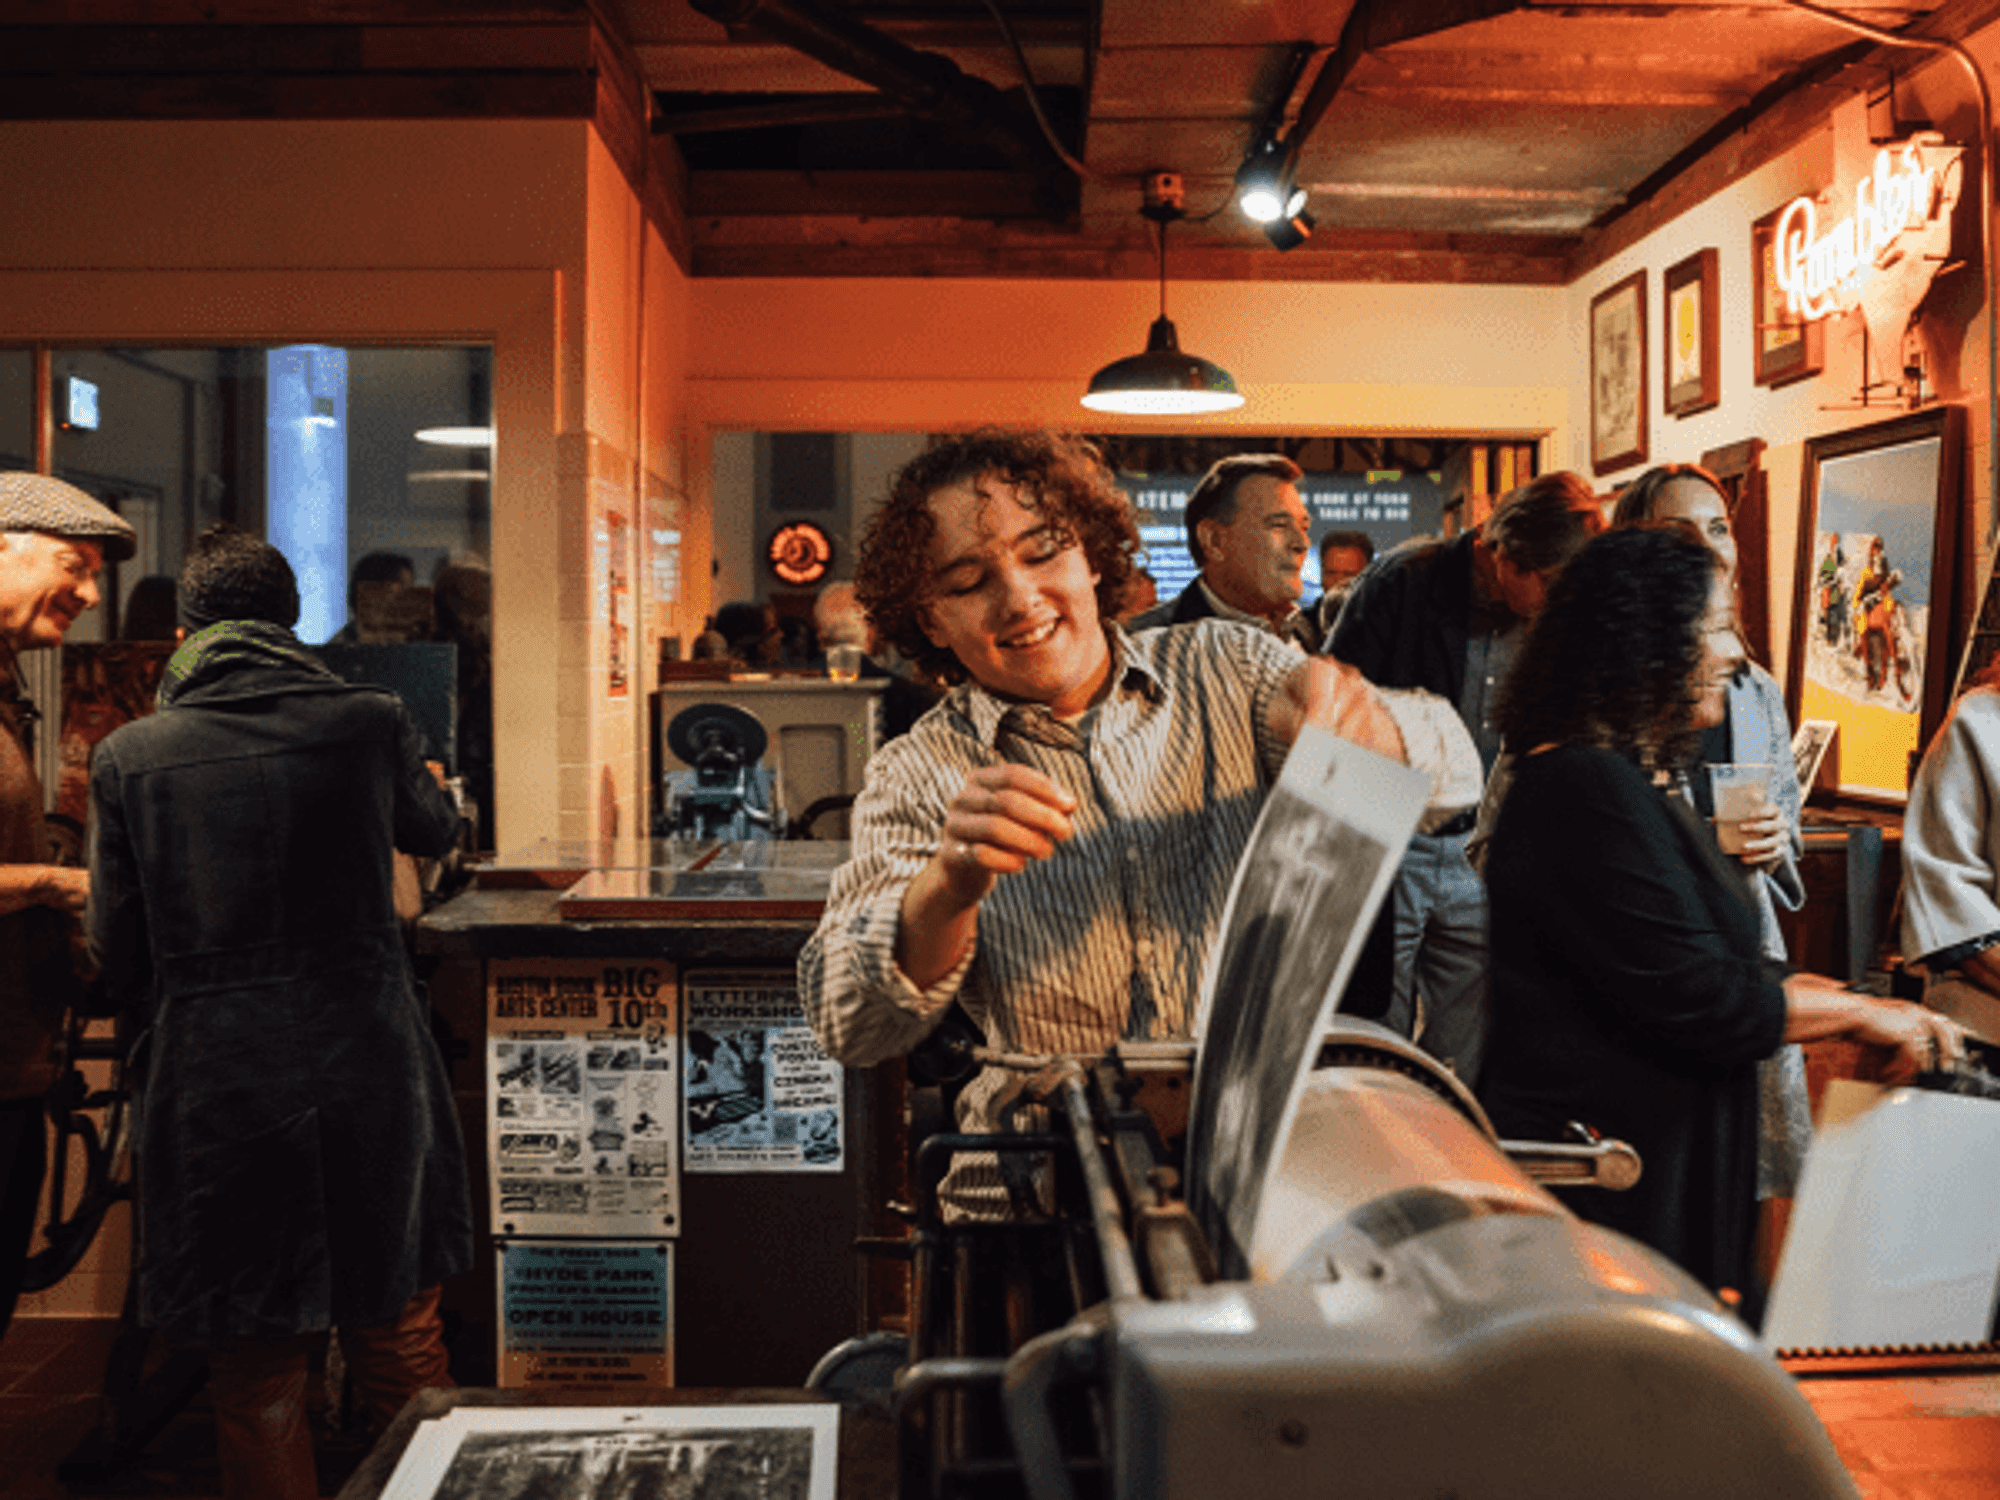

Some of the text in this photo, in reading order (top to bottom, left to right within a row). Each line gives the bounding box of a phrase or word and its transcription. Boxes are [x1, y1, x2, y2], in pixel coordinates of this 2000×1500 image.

[603, 968, 659, 997] BIG
[496, 998, 597, 1017] ARTS CENTER
[608, 1000, 668, 1028] 10th
[691, 1006, 804, 1017] WORKSHO
[771, 1042, 821, 1054] CUSTO
[776, 1052, 827, 1064] POSTE
[525, 1267, 656, 1282] HYDE PARK
[509, 1310, 662, 1325] OPEN HOUSE
